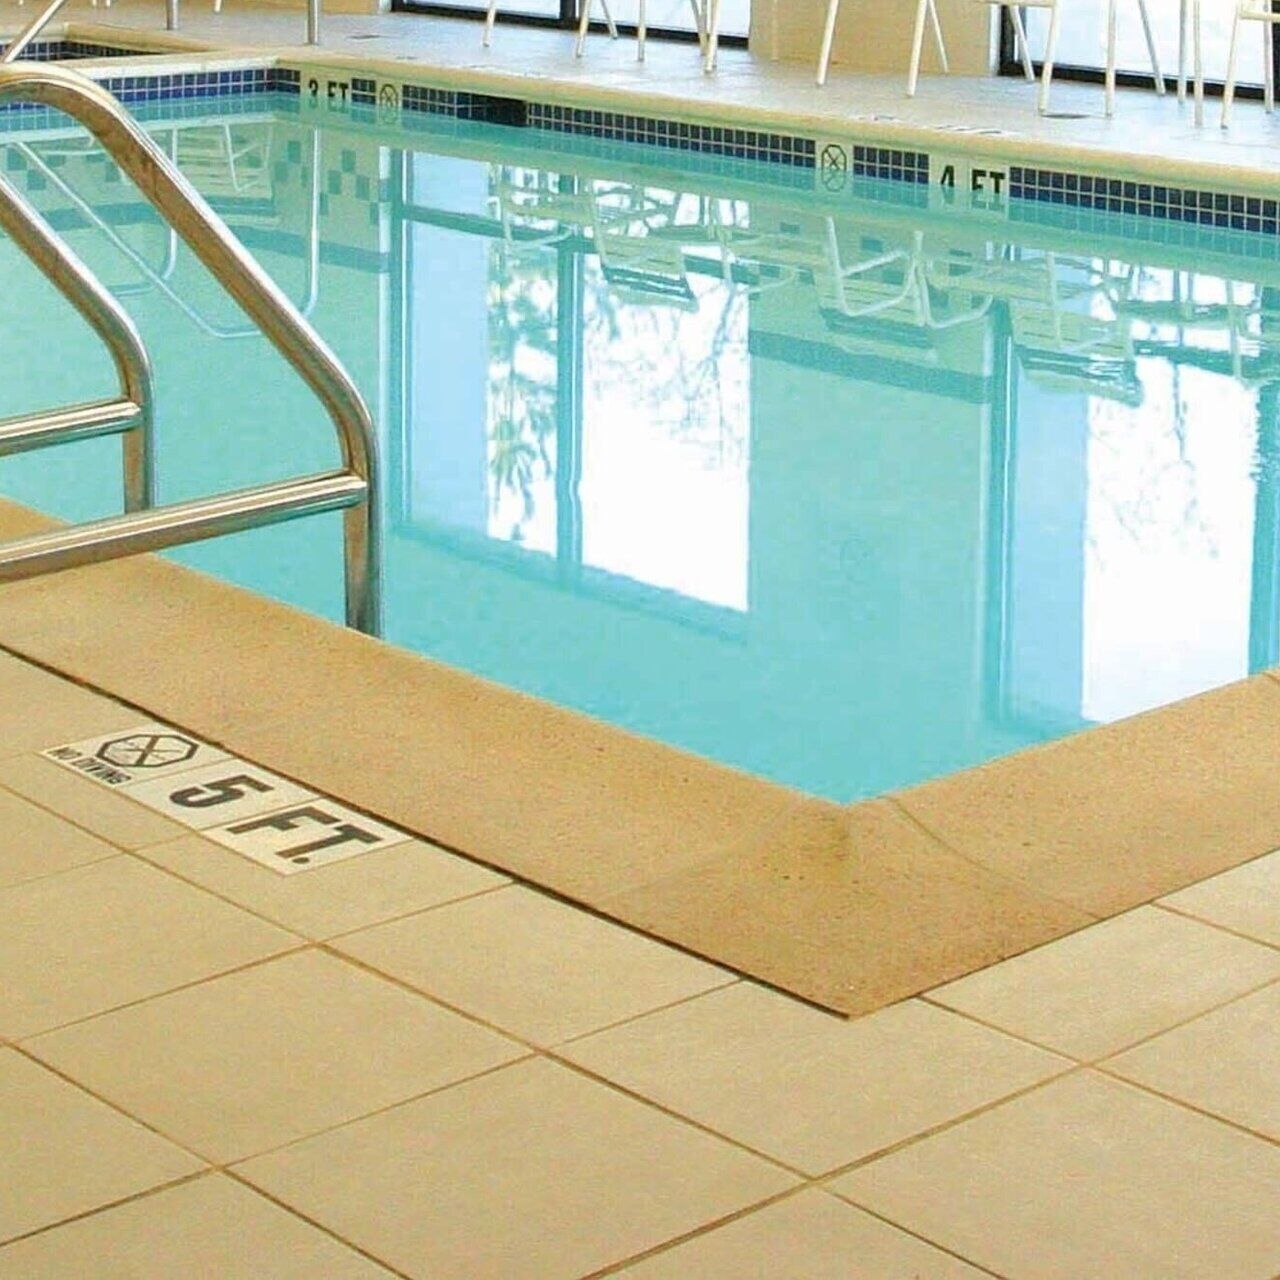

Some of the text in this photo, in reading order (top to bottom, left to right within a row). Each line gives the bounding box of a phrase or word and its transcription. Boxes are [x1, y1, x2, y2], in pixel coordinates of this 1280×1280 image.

[971, 169, 1007, 194] FT
[46, 746, 132, 786] NO DIVING
[169, 774, 274, 808] 5
